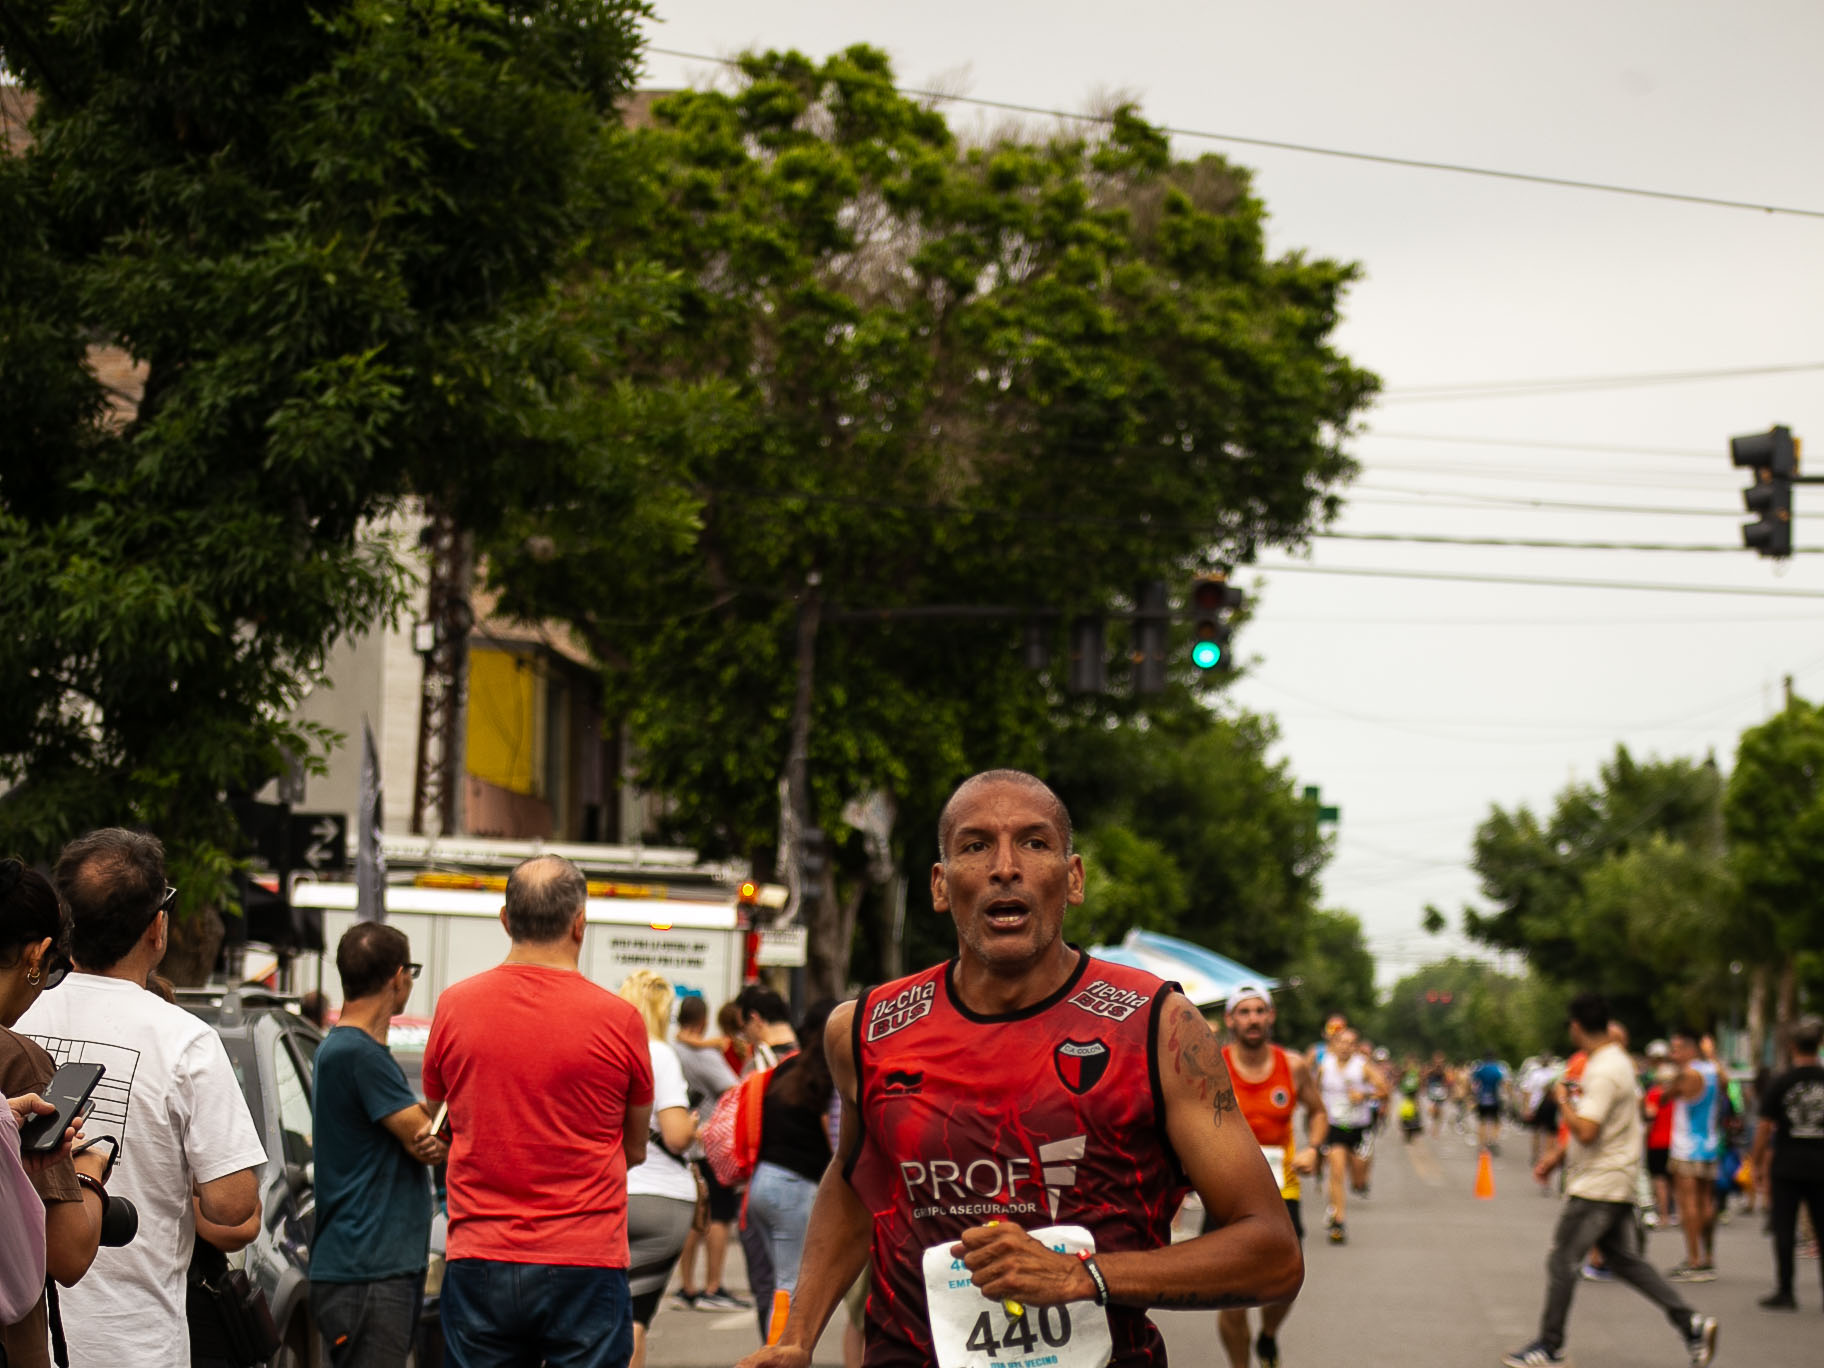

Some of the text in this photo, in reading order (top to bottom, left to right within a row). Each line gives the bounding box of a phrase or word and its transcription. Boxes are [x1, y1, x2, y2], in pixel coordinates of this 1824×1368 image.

[871, 981, 936, 1021] flecha
[1076, 992, 1128, 1018] BUS
[1085, 980, 1150, 1008] flecha
[870, 1001, 928, 1039] BUS
[900, 1158, 1031, 1202] PROF
[949, 1203, 1037, 1215] ASEGURADOR
[966, 1303, 1072, 1358] 440
[1024, 1355, 1058, 1368] VECINO
